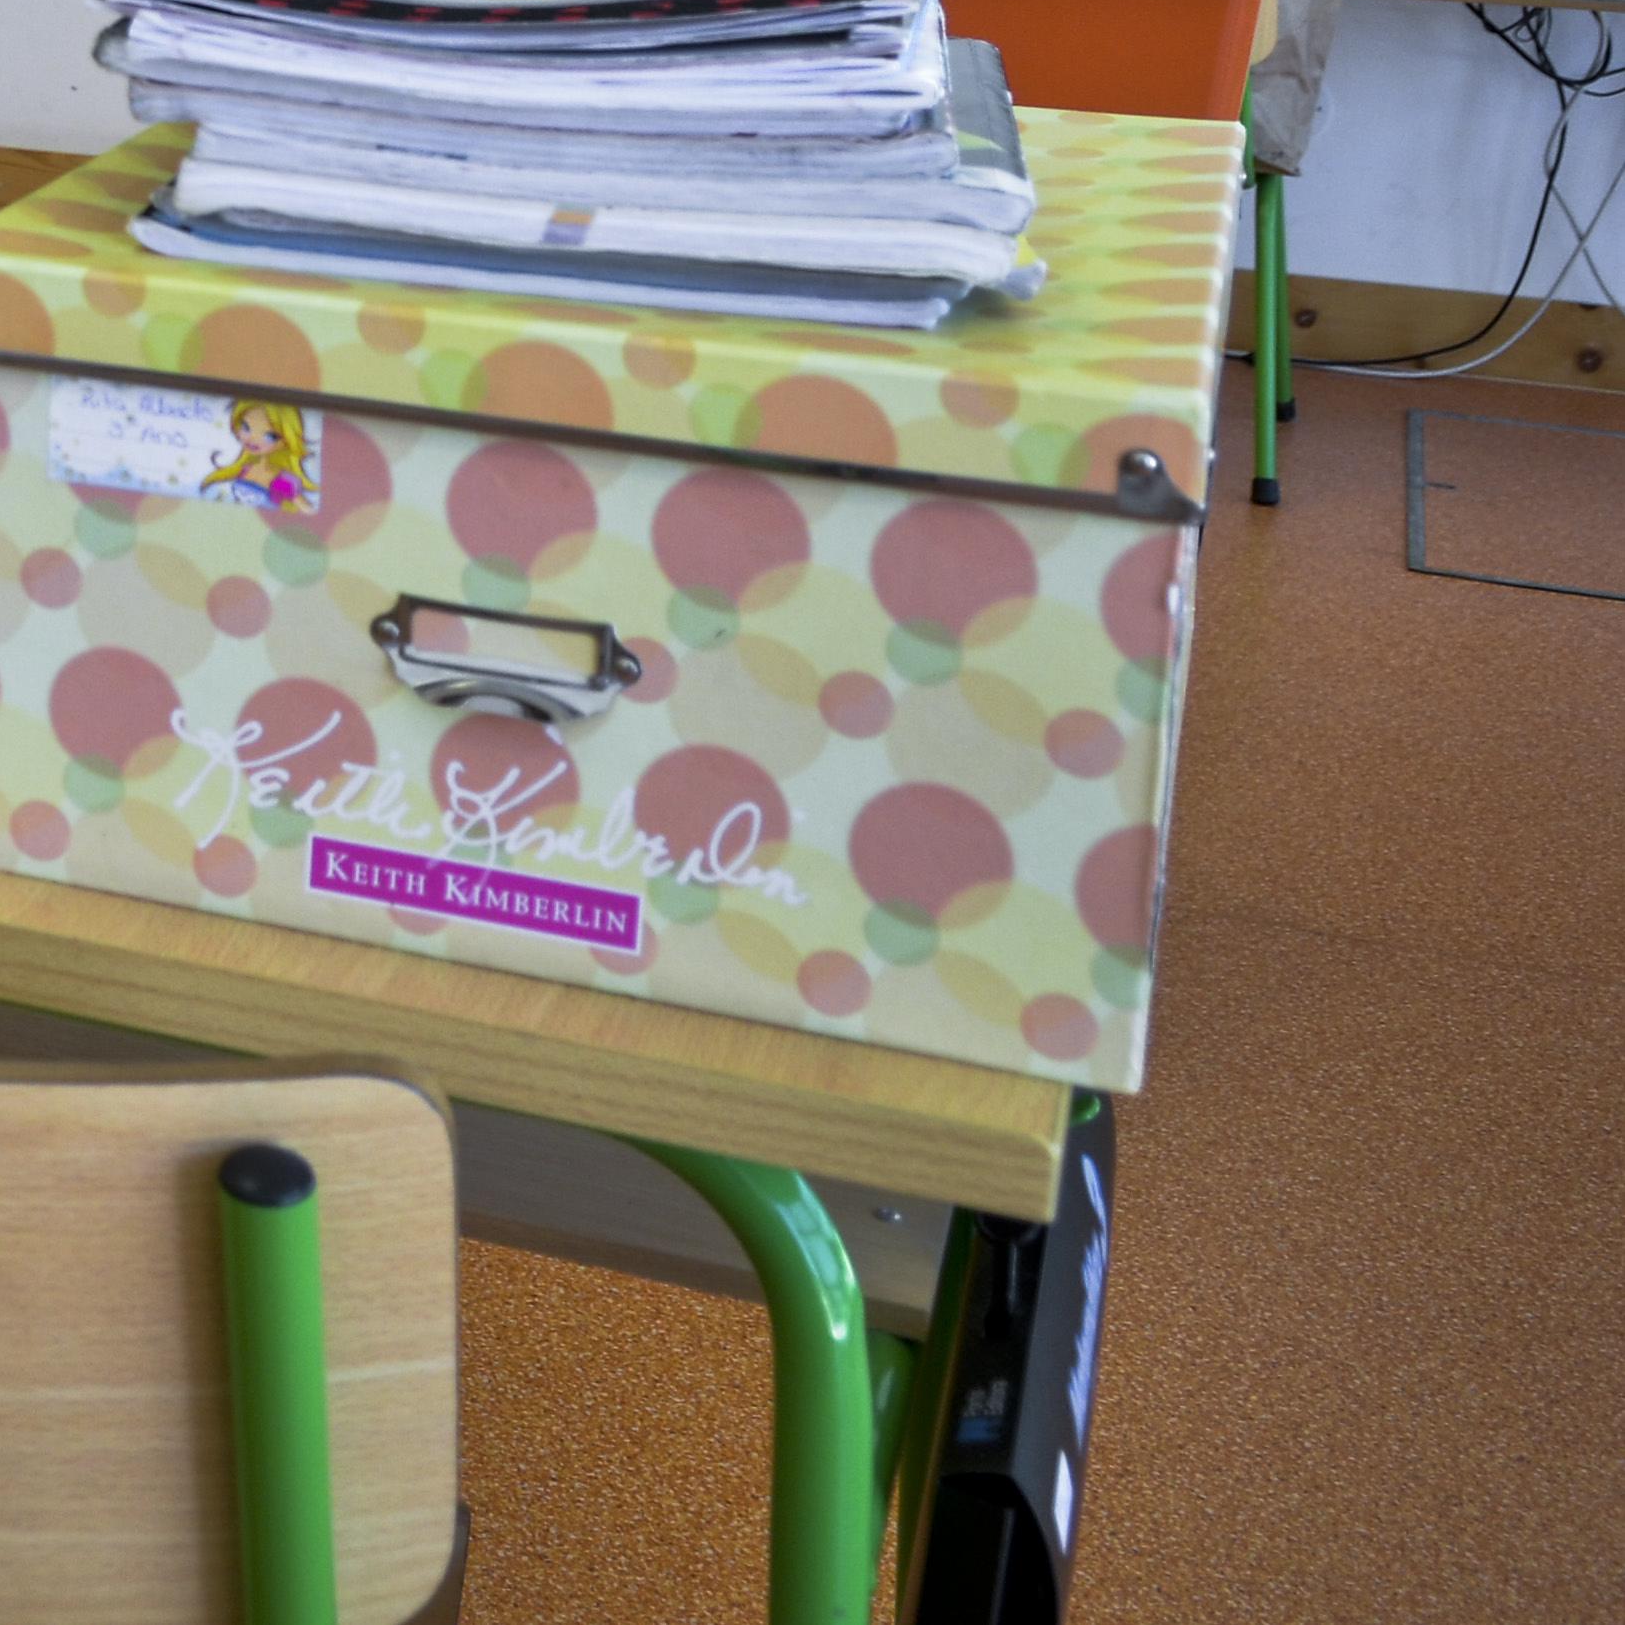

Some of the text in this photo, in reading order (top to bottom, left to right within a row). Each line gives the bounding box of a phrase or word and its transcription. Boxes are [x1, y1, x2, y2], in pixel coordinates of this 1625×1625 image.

[170, 707, 810, 905] Keith Kimberlin
[324, 850, 628, 934] KEITH KIMBERLIN
